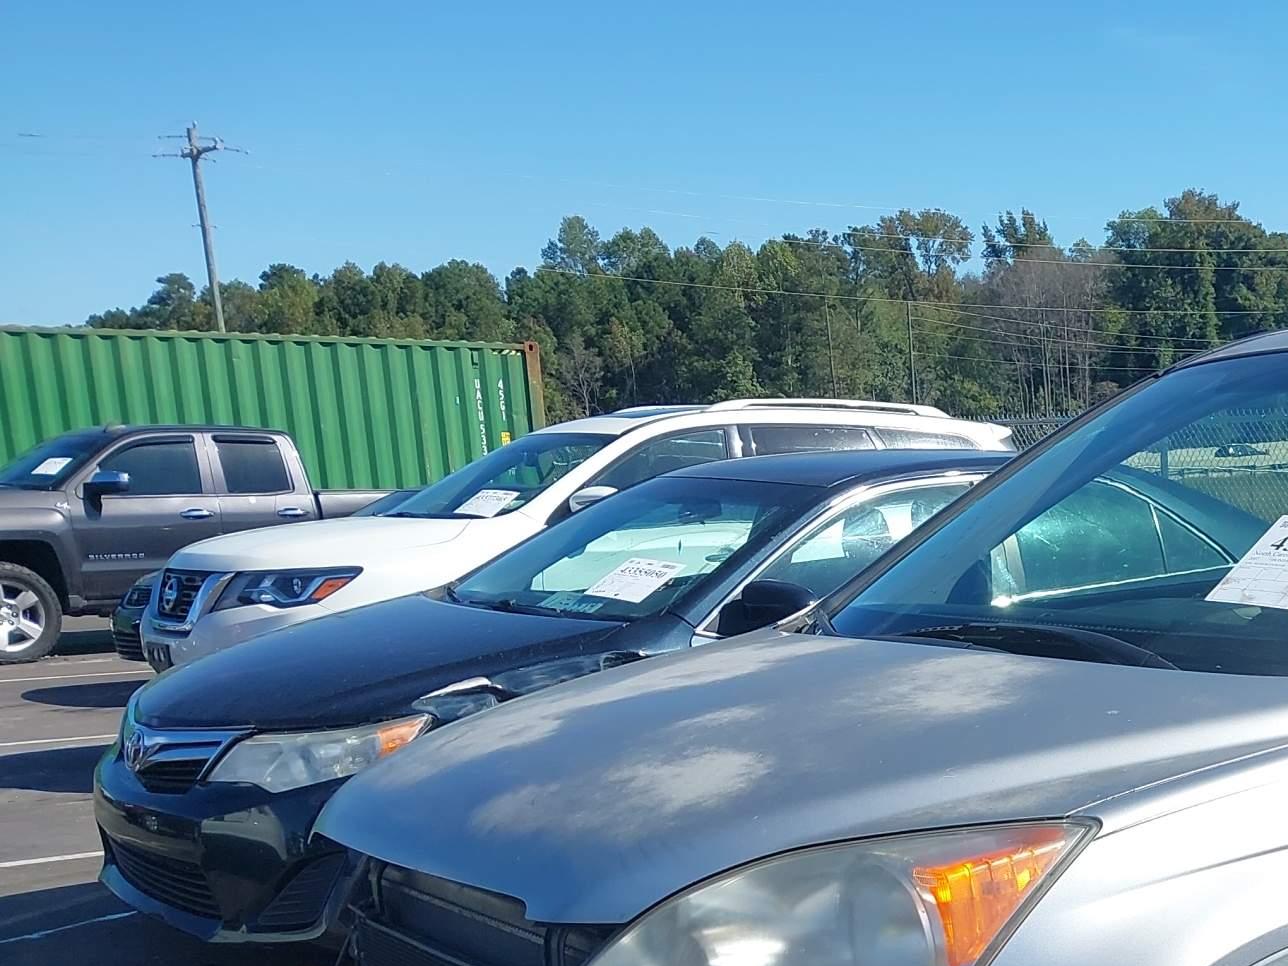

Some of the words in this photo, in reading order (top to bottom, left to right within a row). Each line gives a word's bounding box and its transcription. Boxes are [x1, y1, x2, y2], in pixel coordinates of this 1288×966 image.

[474, 378, 484, 421] UACU
[497, 378, 506, 421] 45G1
[88, 552, 145, 561] SILVERADO
